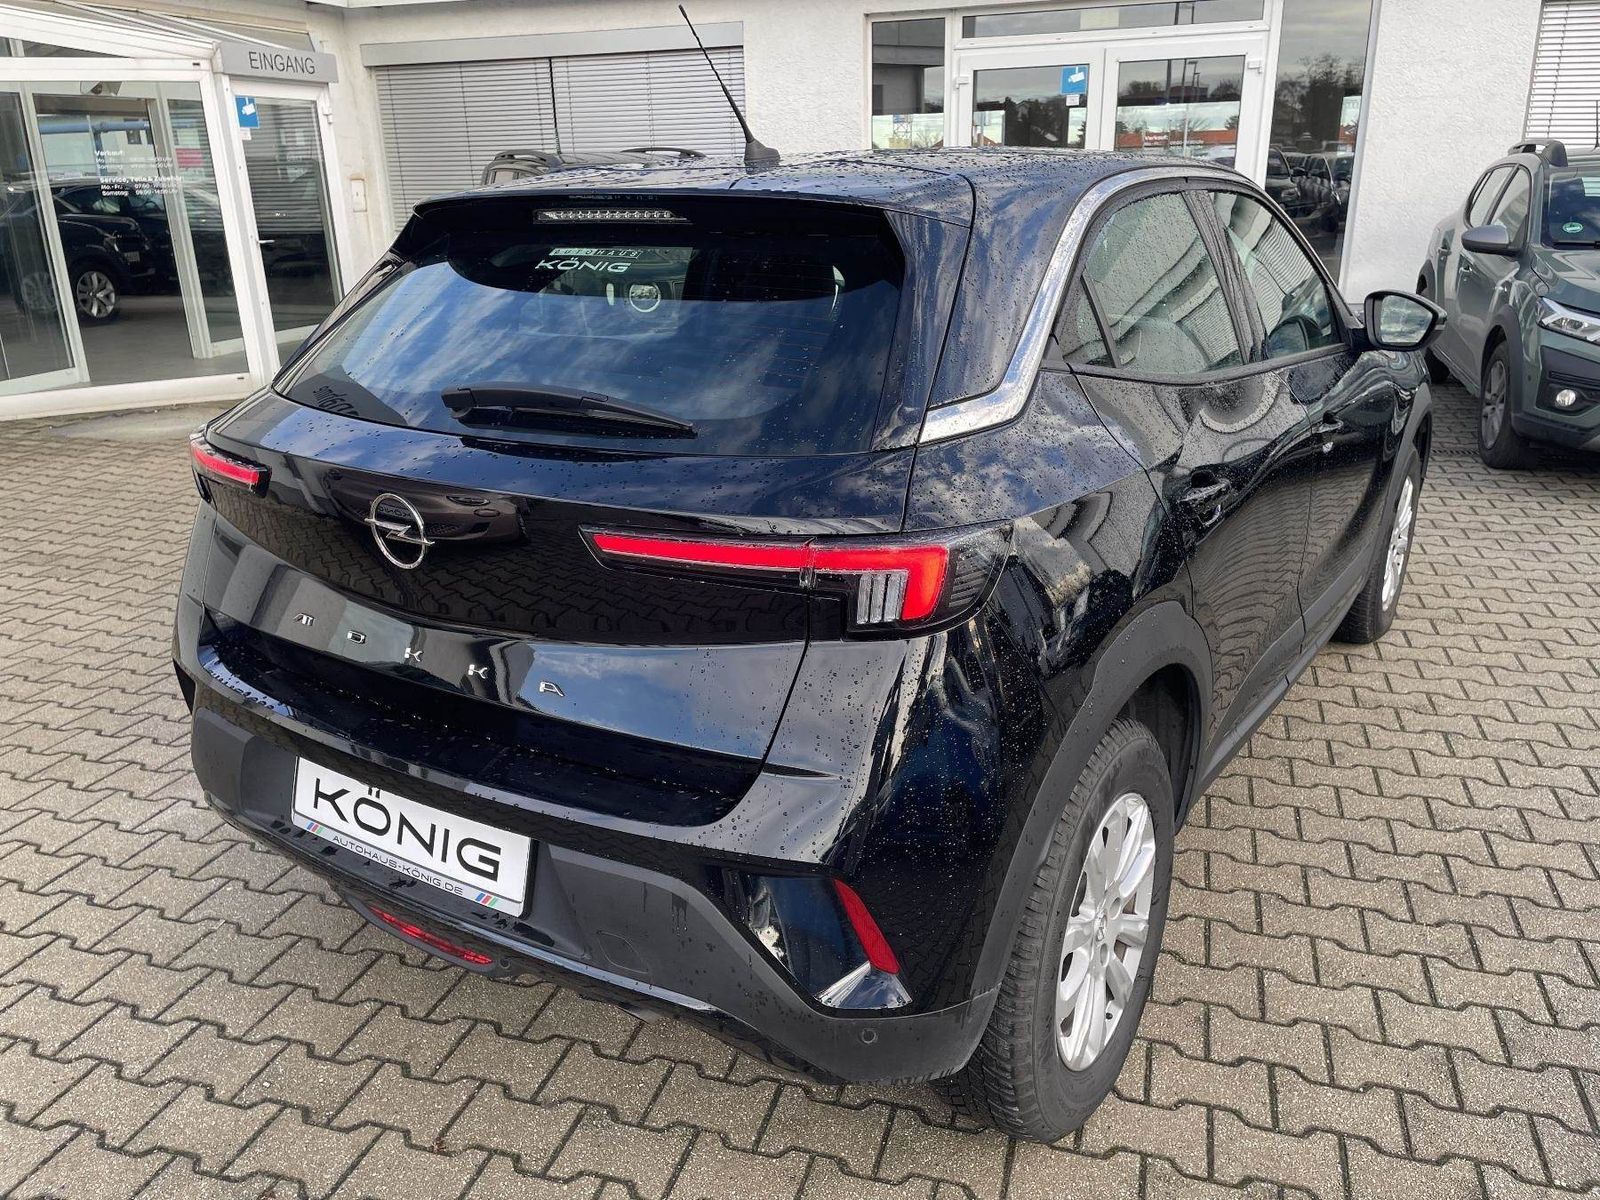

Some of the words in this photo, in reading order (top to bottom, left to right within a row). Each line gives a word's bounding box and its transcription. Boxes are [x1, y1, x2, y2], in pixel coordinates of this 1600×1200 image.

[249, 51, 315, 74] EINGANG
[535, 257, 631, 273] KÖNIG
[313, 777, 501, 882] KÖNIG
[332, 834, 464, 896] AUTOHAUS-KÖNIG.DE
